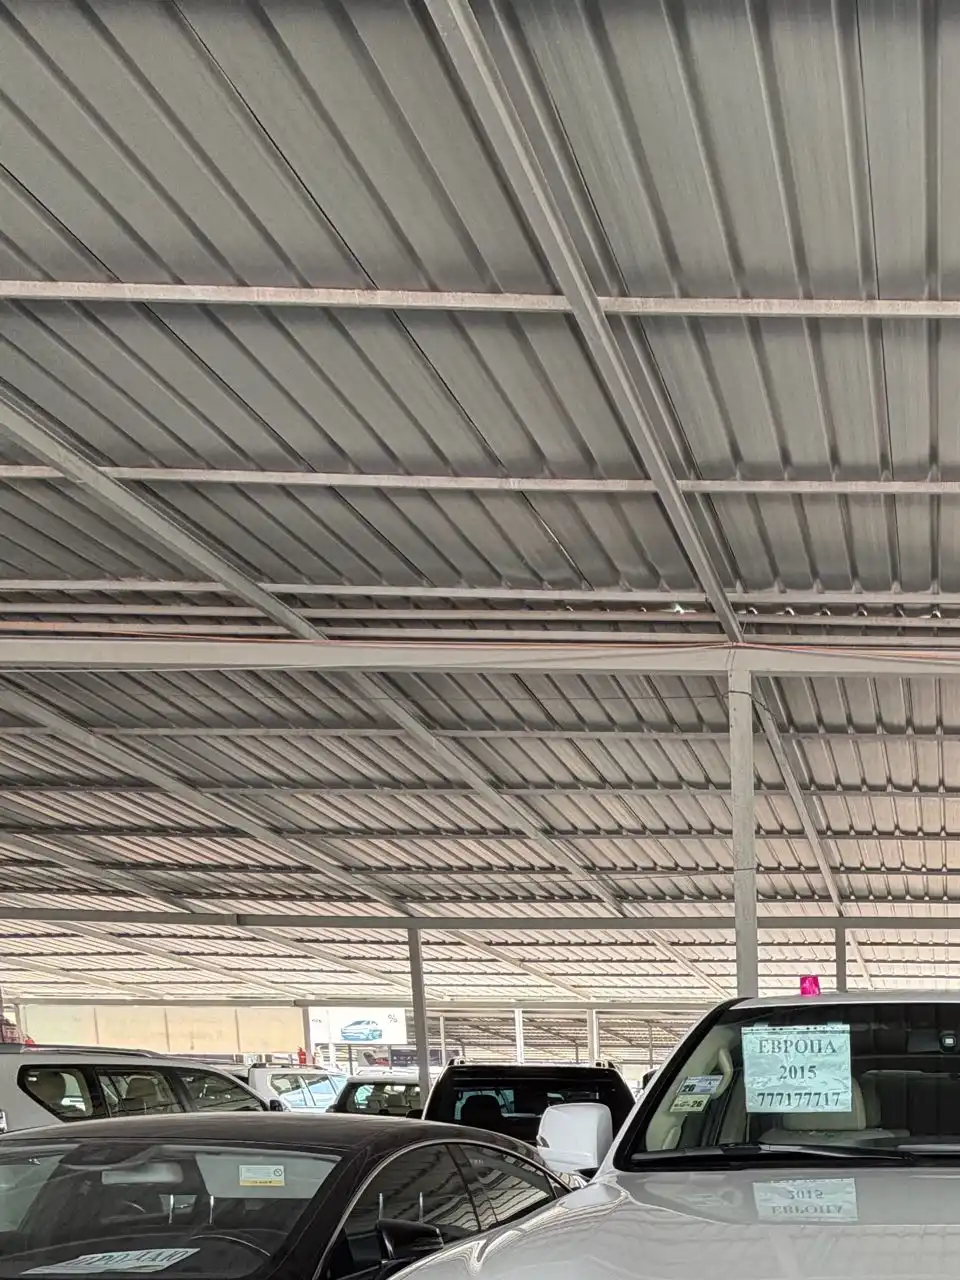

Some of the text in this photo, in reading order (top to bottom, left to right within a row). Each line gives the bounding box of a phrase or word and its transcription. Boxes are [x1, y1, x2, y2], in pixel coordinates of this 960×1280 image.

[758, 1039, 837, 1054] ЕВРОПА
[779, 1065, 817, 1080] 2015
[757, 1092, 841, 1107] 777177717
